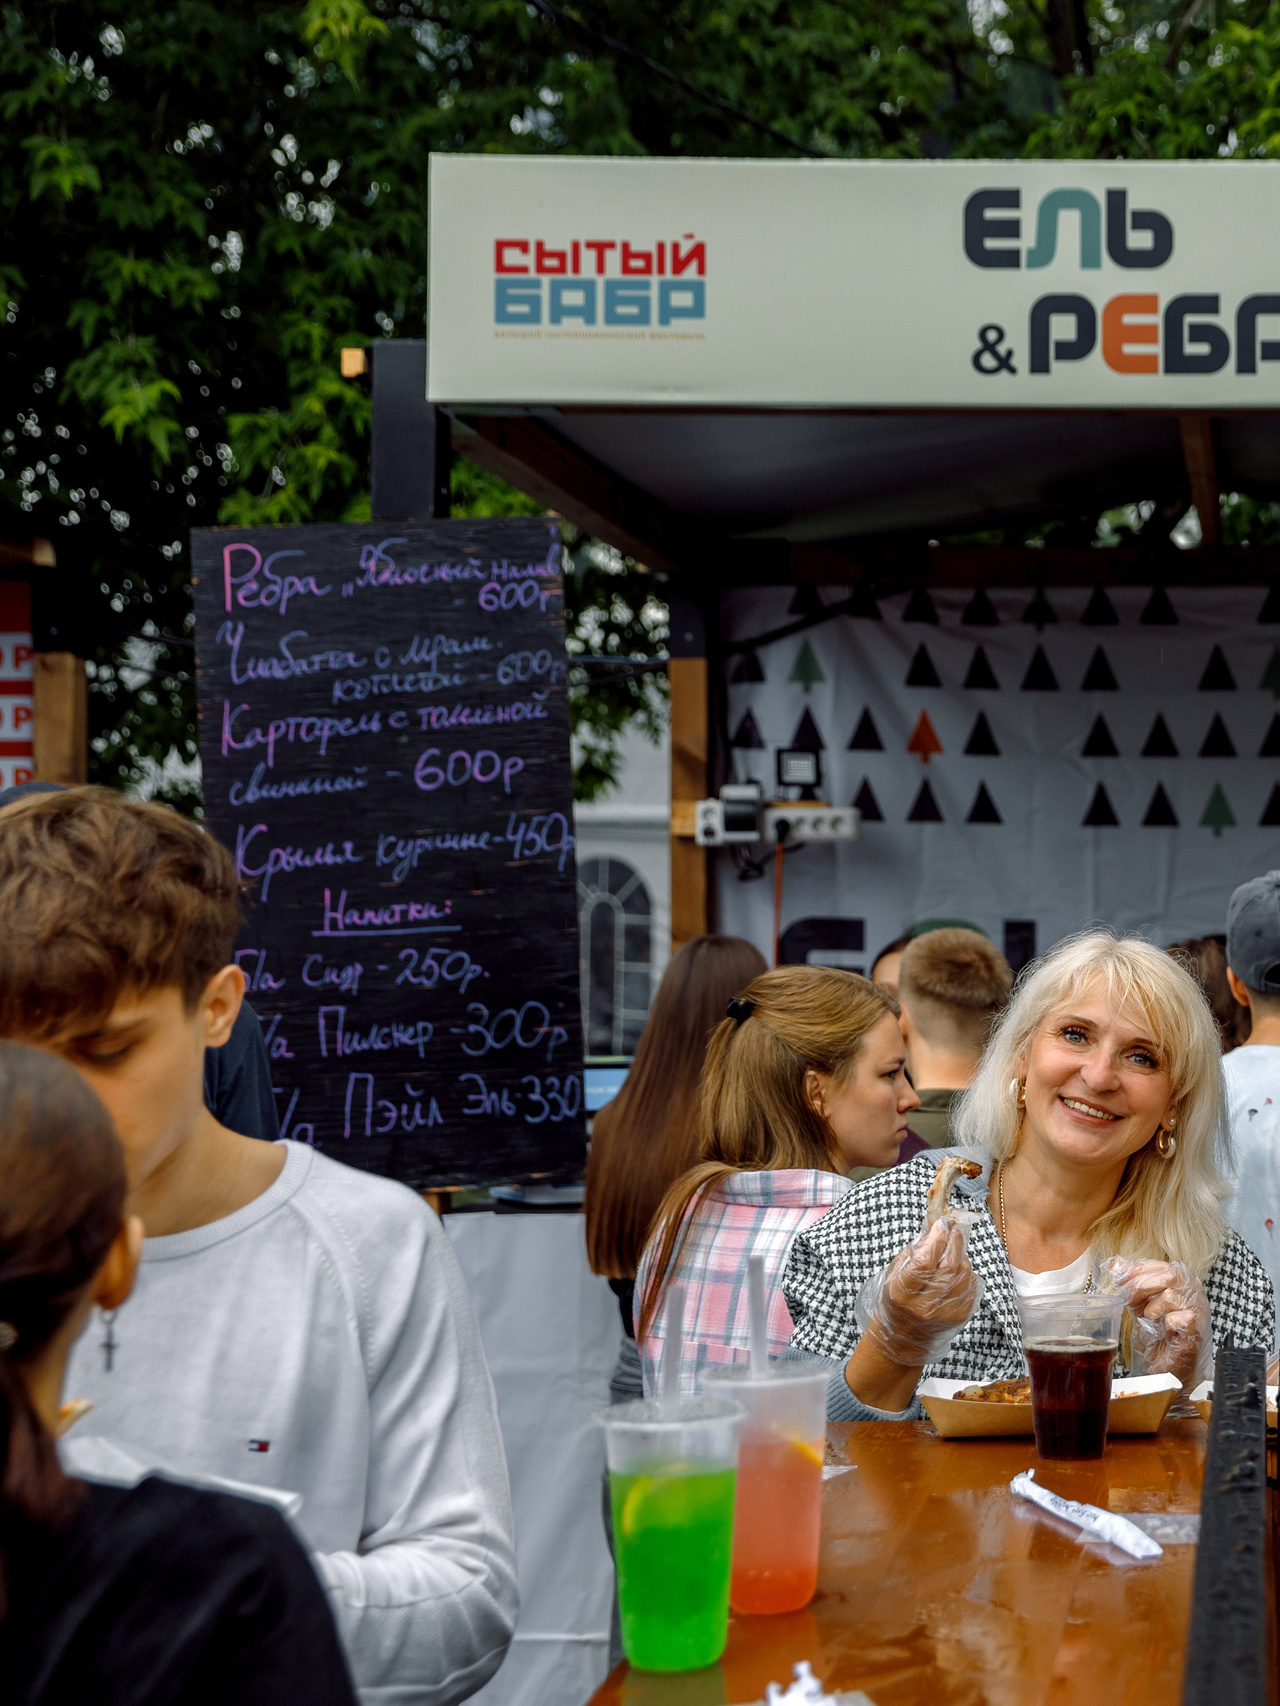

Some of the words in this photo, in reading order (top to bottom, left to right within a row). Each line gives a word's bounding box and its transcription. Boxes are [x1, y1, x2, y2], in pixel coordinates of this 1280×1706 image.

[963, 187, 1175, 271] ЕЛЬ
[494, 233, 707, 276] СЫТЫЙ
[494, 278, 706, 326] БАБР
[222, 699, 382, 769] Картофель
[414, 748, 524, 794] 600р
[301, 954, 364, 996] Сидр
